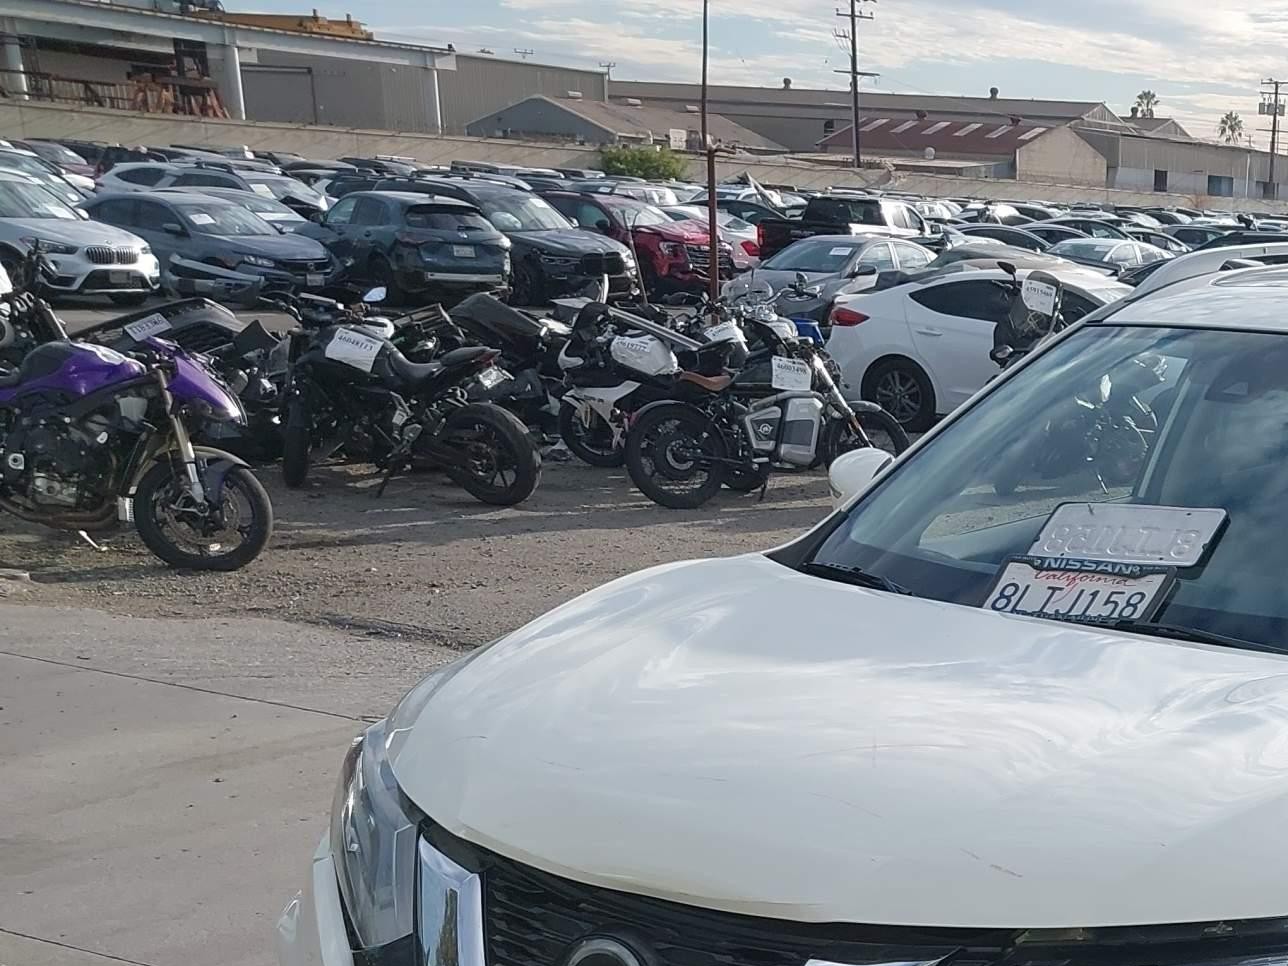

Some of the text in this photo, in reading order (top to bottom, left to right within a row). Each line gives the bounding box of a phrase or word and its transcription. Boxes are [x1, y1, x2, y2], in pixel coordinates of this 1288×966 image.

[1042, 557, 1134, 576] NISSAN
[1033, 569, 1137, 597] California
[990, 582, 1147, 620] 8LTJ158
